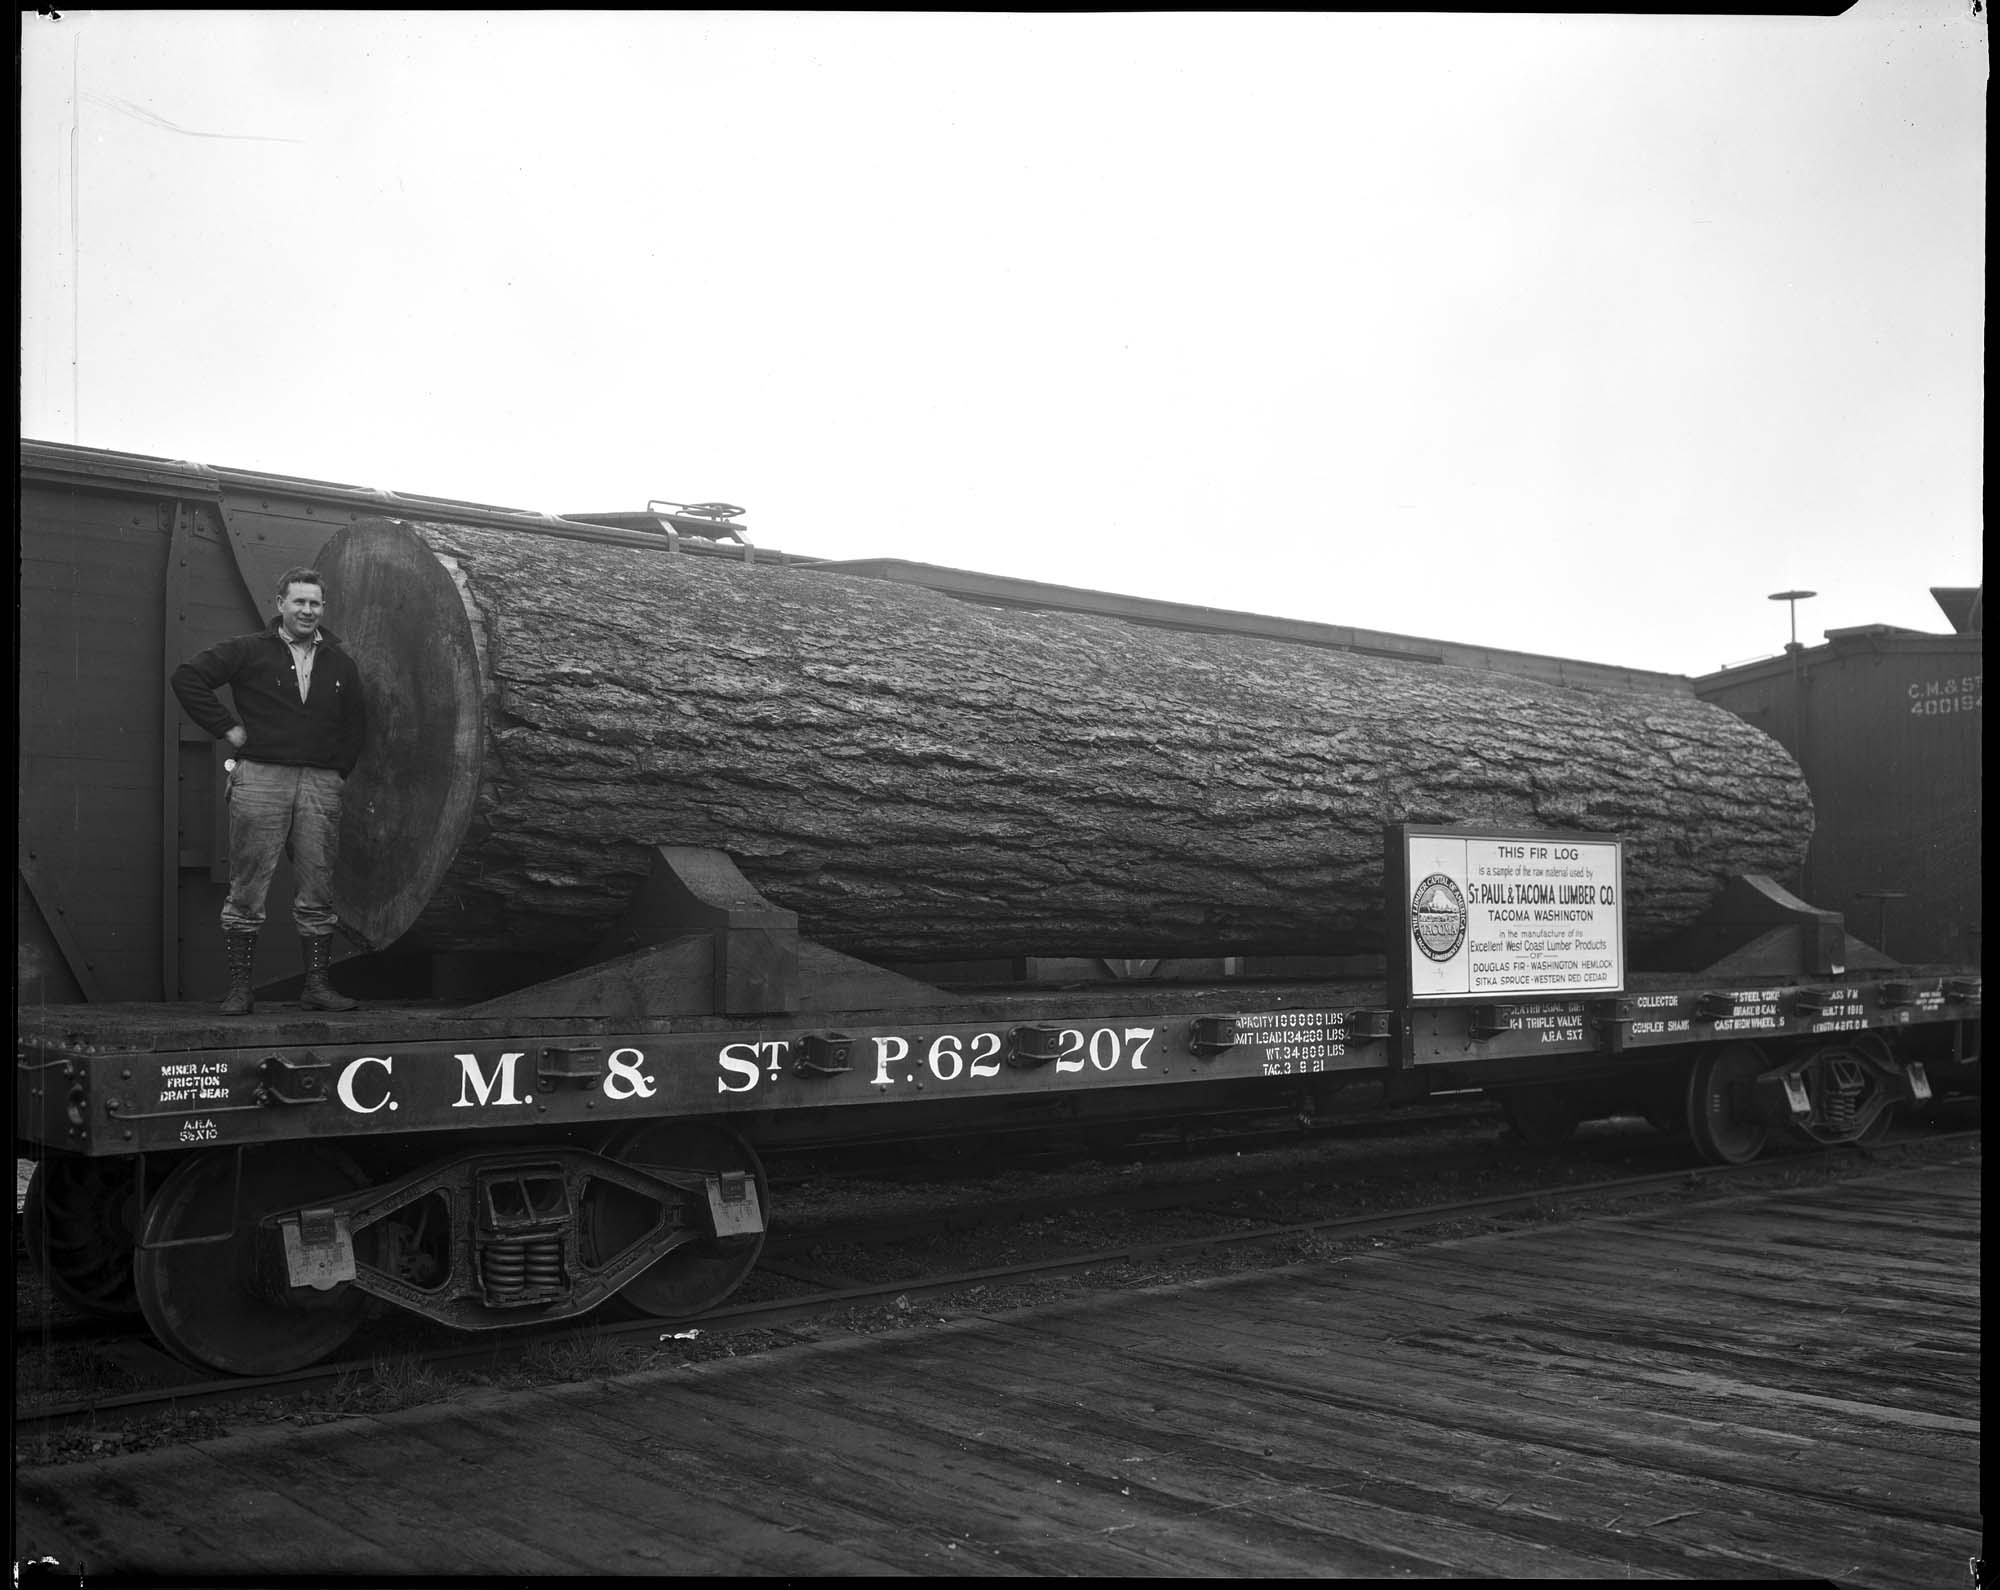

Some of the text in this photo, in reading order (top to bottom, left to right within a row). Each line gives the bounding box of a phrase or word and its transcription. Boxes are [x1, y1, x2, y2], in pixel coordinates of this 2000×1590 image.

[1498, 846, 1579, 861] THIS FIR LOG
[1486, 867, 1492, 876] a
[1492, 865, 1513, 879] sample
[1515, 864, 1522, 876] of
[1532, 868, 1544, 877] raw
[1545, 866, 1569, 878] material
[1569, 867, 1584, 878] used
[1586, 867, 1594, 881] by
[1515, 884, 1556, 905] TACOMA
[1559, 885, 1596, 905] LUMBER
[1600, 885, 1616, 906] CO.
[1488, 910, 1594, 922] TACOMA WASHINGTON
[1420, 924, 1458, 936] TACOMA
[1499, 929, 1506, 938] in
[1507, 929, 1518, 938] the
[1521, 929, 1565, 938] manufacture
[1568, 928, 1575, 938] of
[1470, 939, 1608, 953] Excellent West Coast Lumber Products
[1530, 952, 1543, 960] OF
[1473, 962, 1510, 973] DOUGLAS
[1513, 962, 1526, 971] FIR
[1530, 960, 1578, 971] WASHINGTON
[1581, 960, 1614, 969] HEMLOCK
[1475, 977, 1498, 986] SITKA
[1500, 975, 1530, 985] SPRUCE
[1534, 974, 1566, 984] WESTERN
[1568, 974, 1582, 983] RED
[1584, 973, 1608, 983] CEDAR
[1637, 995, 1679, 1009] COLLECTOR
[1235, 1012, 1344, 1029] APACITY 100000 LBS
[1526, 1016, 1555, 1029] TRIPLE
[1556, 1015, 1583, 1027] VALVE
[1632, 1021, 1665, 1034] COUPLER
[1714, 1019, 1733, 1031] CAST
[1256, 1031, 1282, 1044] LOAD
[1283, 1030, 1323, 1044] 134200
[1326, 1028, 1345, 1041] LBS
[1266, 1044, 1345, 1061] WT. 34800 LBS
[161, 1064, 198, 1077] MINER
[1263, 1064, 1283, 1076] TAC.
[1284, 1062, 1291, 1074] 3
[1313, 1060, 1324, 1072] 21
[167, 1076, 221, 1088] FRICTION
[336, 1056, 399, 1114] C.
[451, 1053, 534, 1107] M.
[603, 1048, 657, 1100] &
[160, 1088, 230, 1102] DRAFT GEAR
